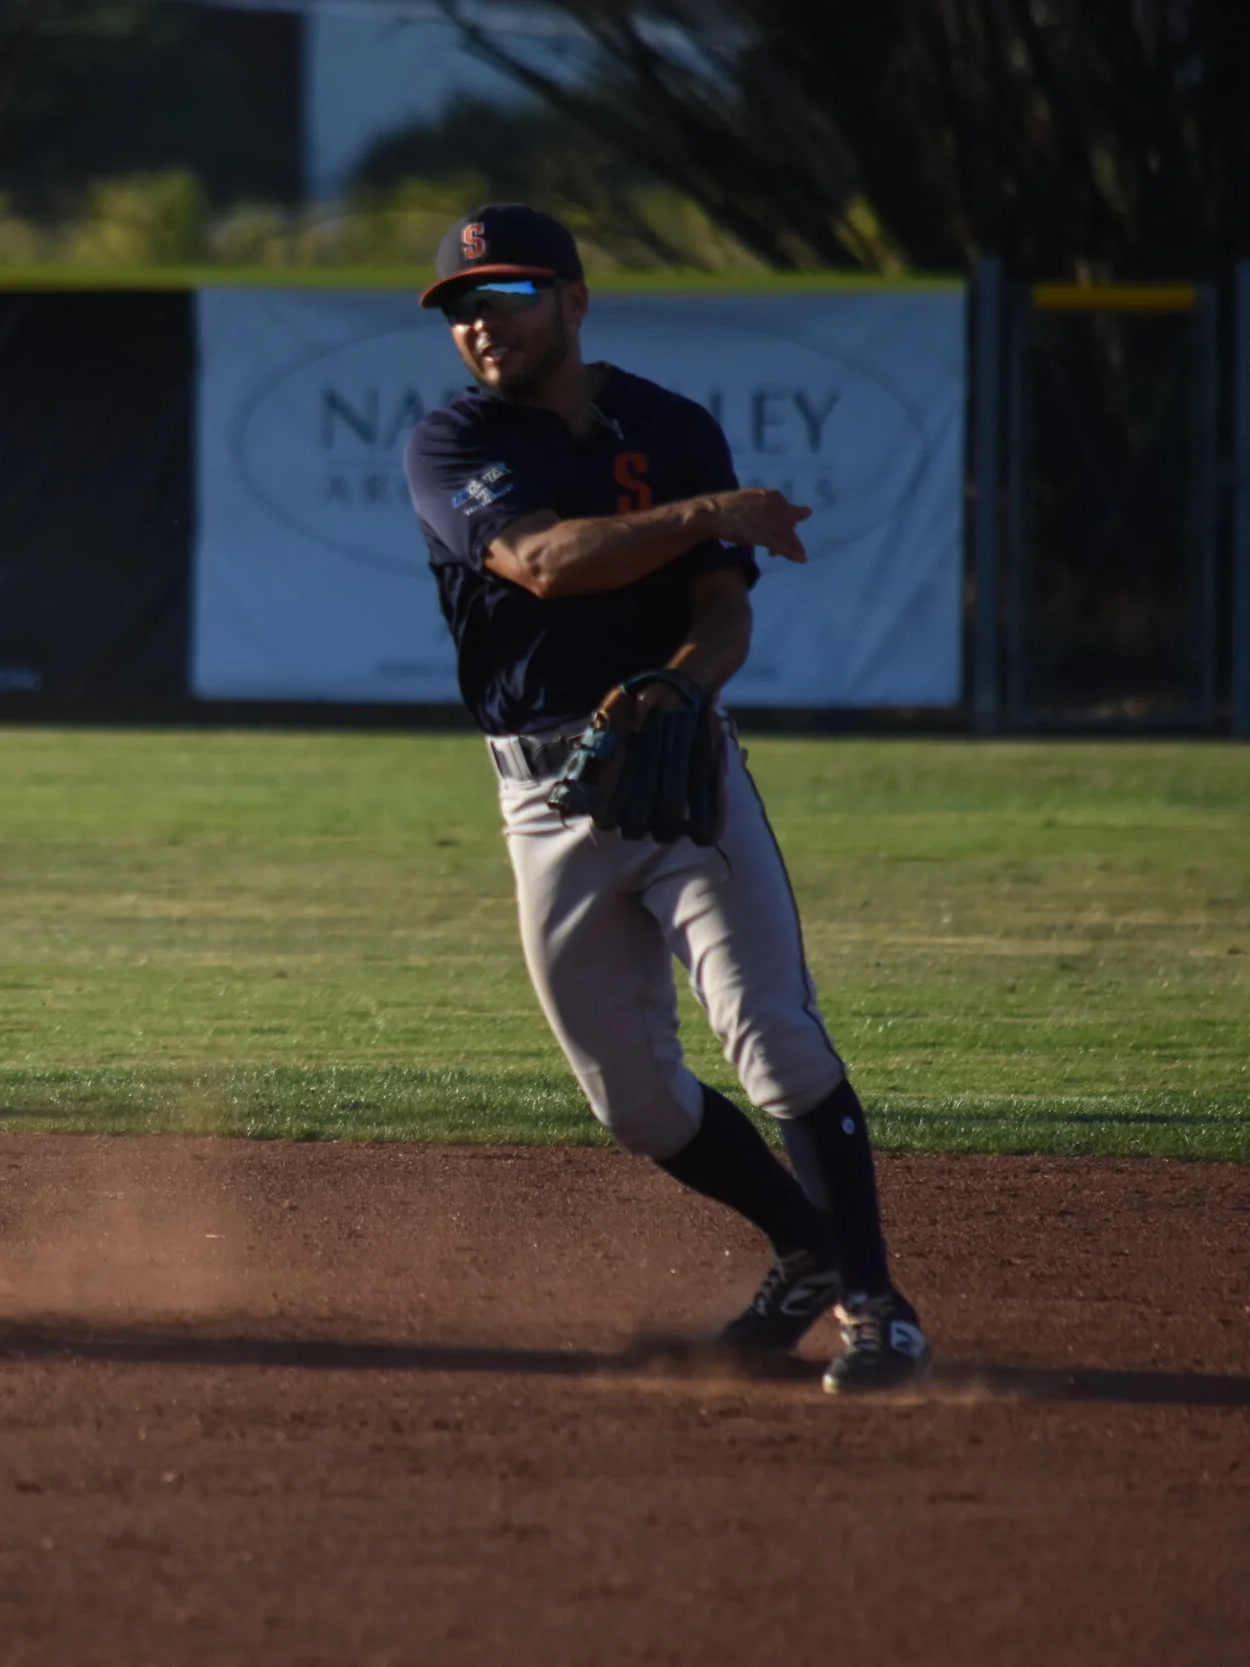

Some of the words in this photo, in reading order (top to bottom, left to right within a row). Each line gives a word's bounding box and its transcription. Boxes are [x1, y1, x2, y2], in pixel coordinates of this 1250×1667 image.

[461, 221, 486, 260] S
[320, 388, 458, 450] NA
[708, 389, 839, 454] LEY
[612, 449, 652, 515] S
